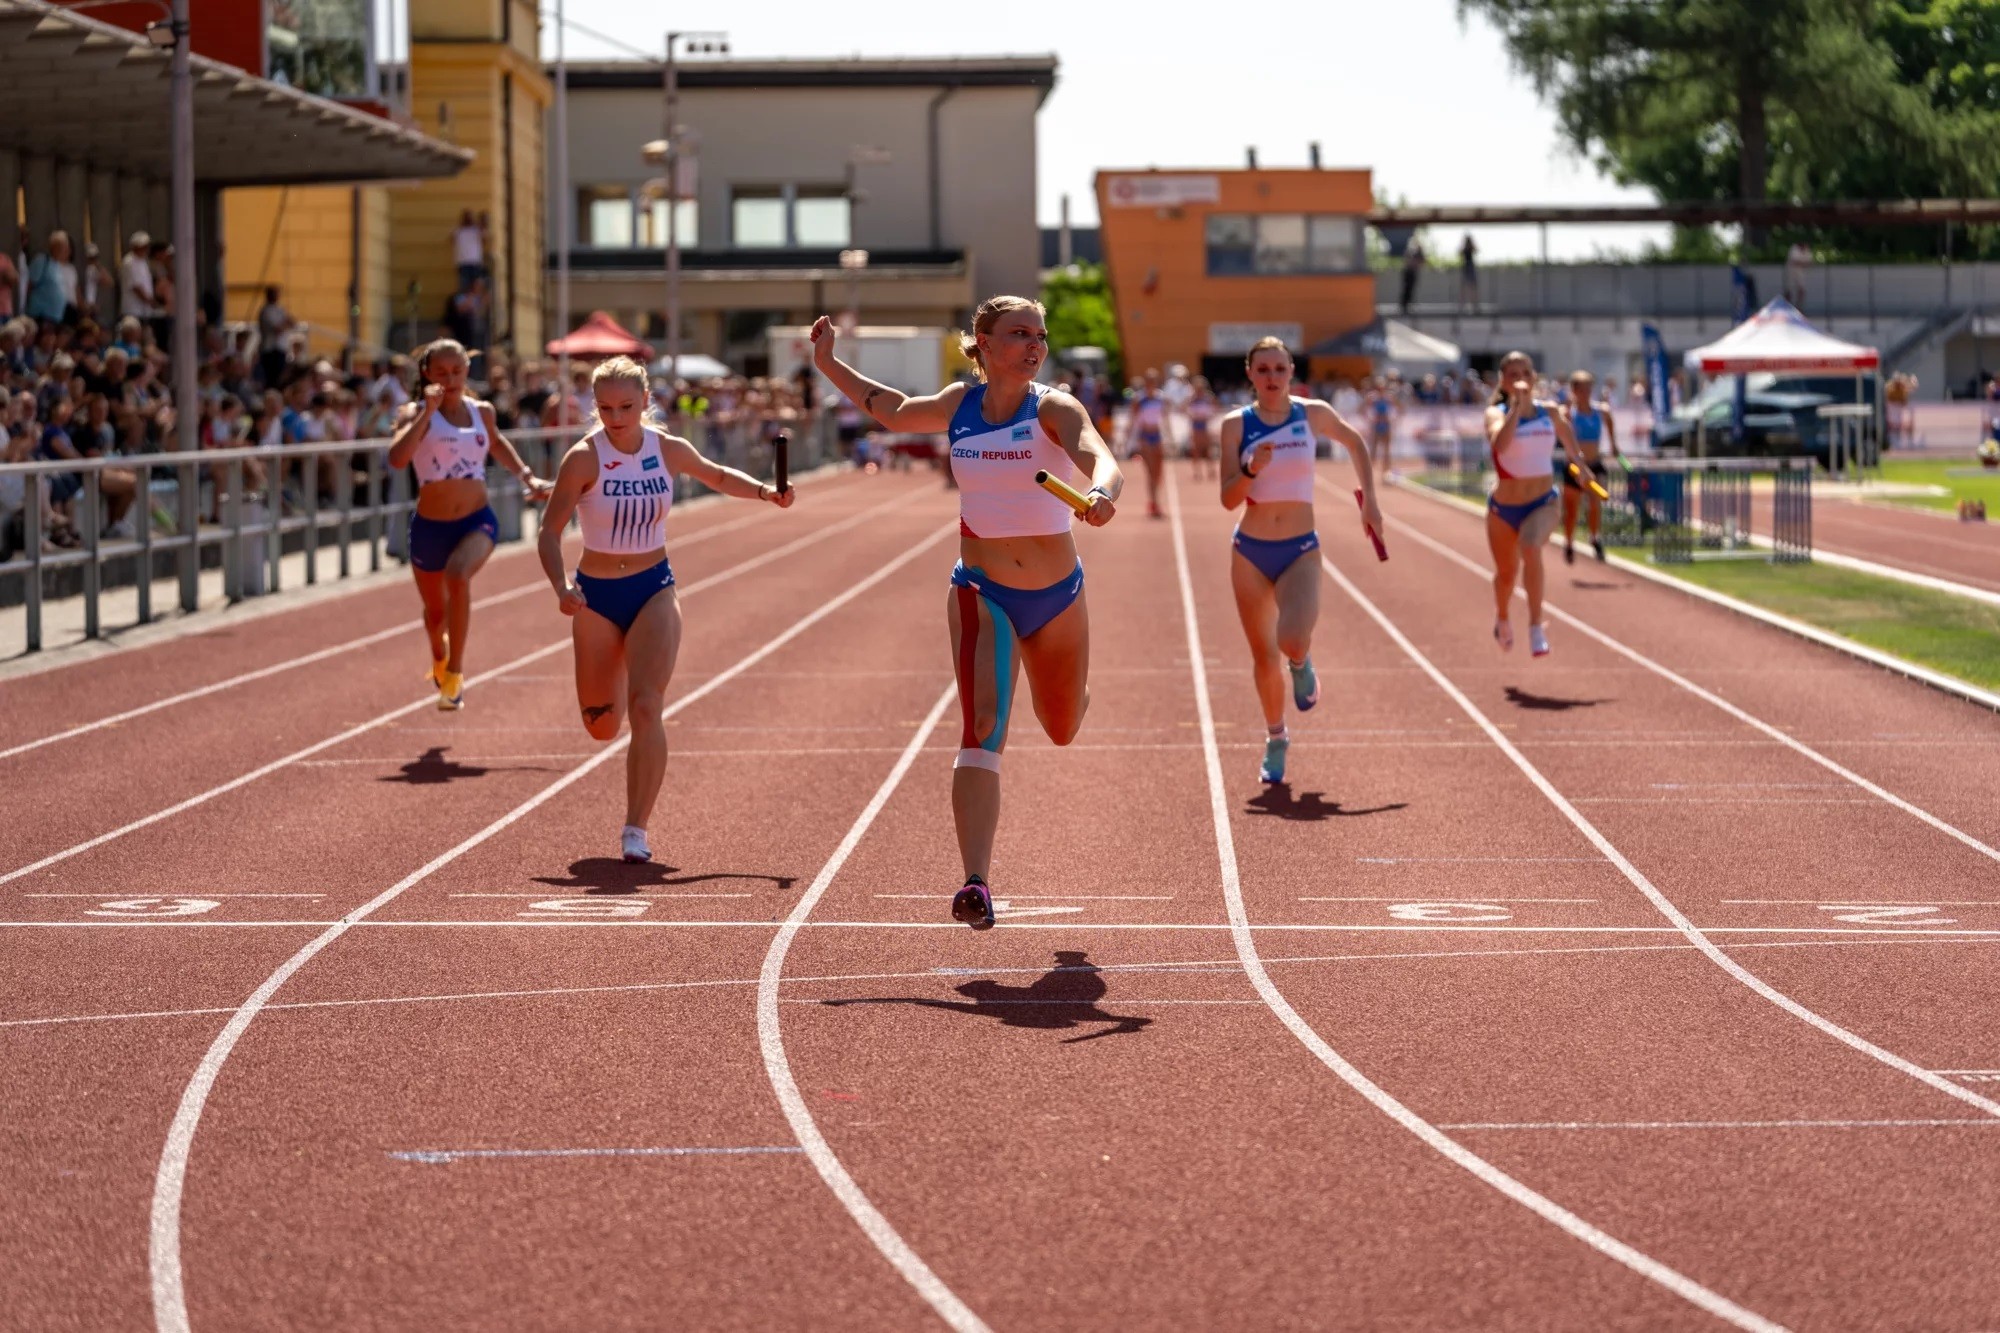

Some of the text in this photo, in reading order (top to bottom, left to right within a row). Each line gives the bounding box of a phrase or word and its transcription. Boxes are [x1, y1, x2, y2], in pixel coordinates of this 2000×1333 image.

[952, 448, 1032, 460] CZECH REPUBLIC
[603, 476, 670, 496] CZECHIA
[516, 899, 652, 916] 5
[1387, 903, 1513, 921] 3
[1817, 905, 1958, 925] 2
